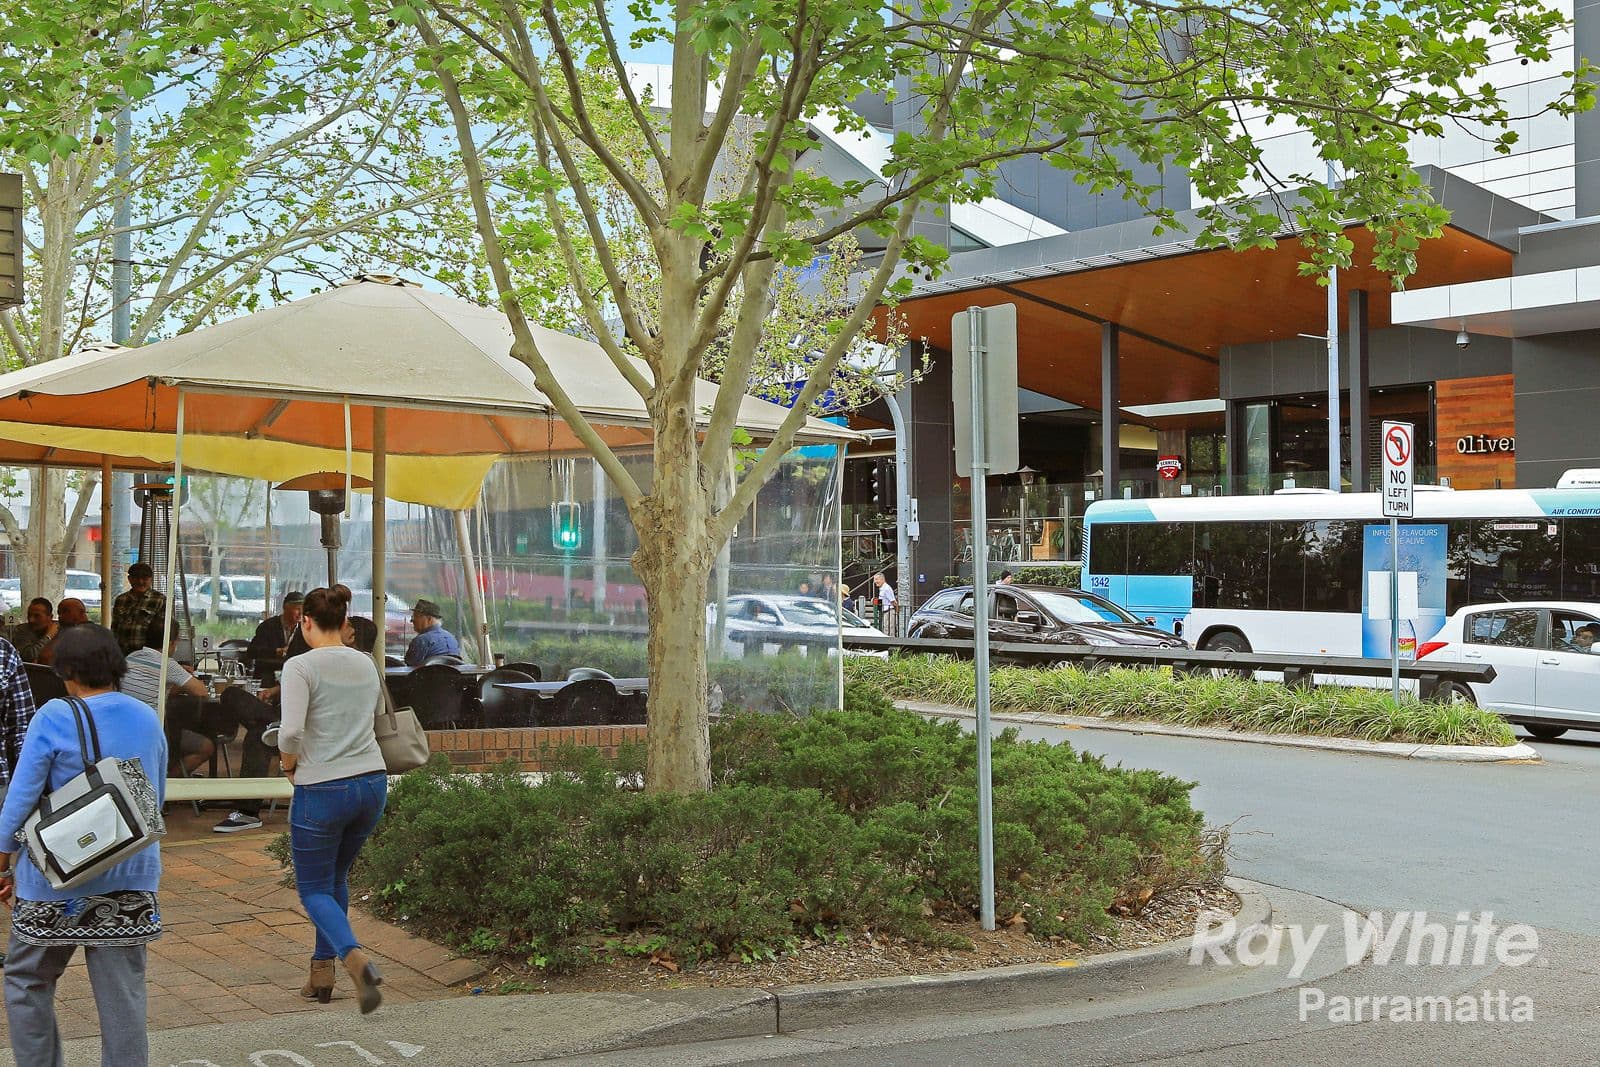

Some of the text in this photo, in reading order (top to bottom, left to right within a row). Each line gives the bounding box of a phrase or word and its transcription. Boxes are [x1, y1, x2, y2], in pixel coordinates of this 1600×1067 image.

[1390, 469, 1406, 484] NO
[1388, 488, 1408, 497] LEFT
[1388, 501, 1409, 511] TURN
[1405, 537, 1425, 545] ALIVE
[1091, 577, 1110, 587] 1342
[9, 615, 14, 623] 2
[203, 637, 208, 647] 6
